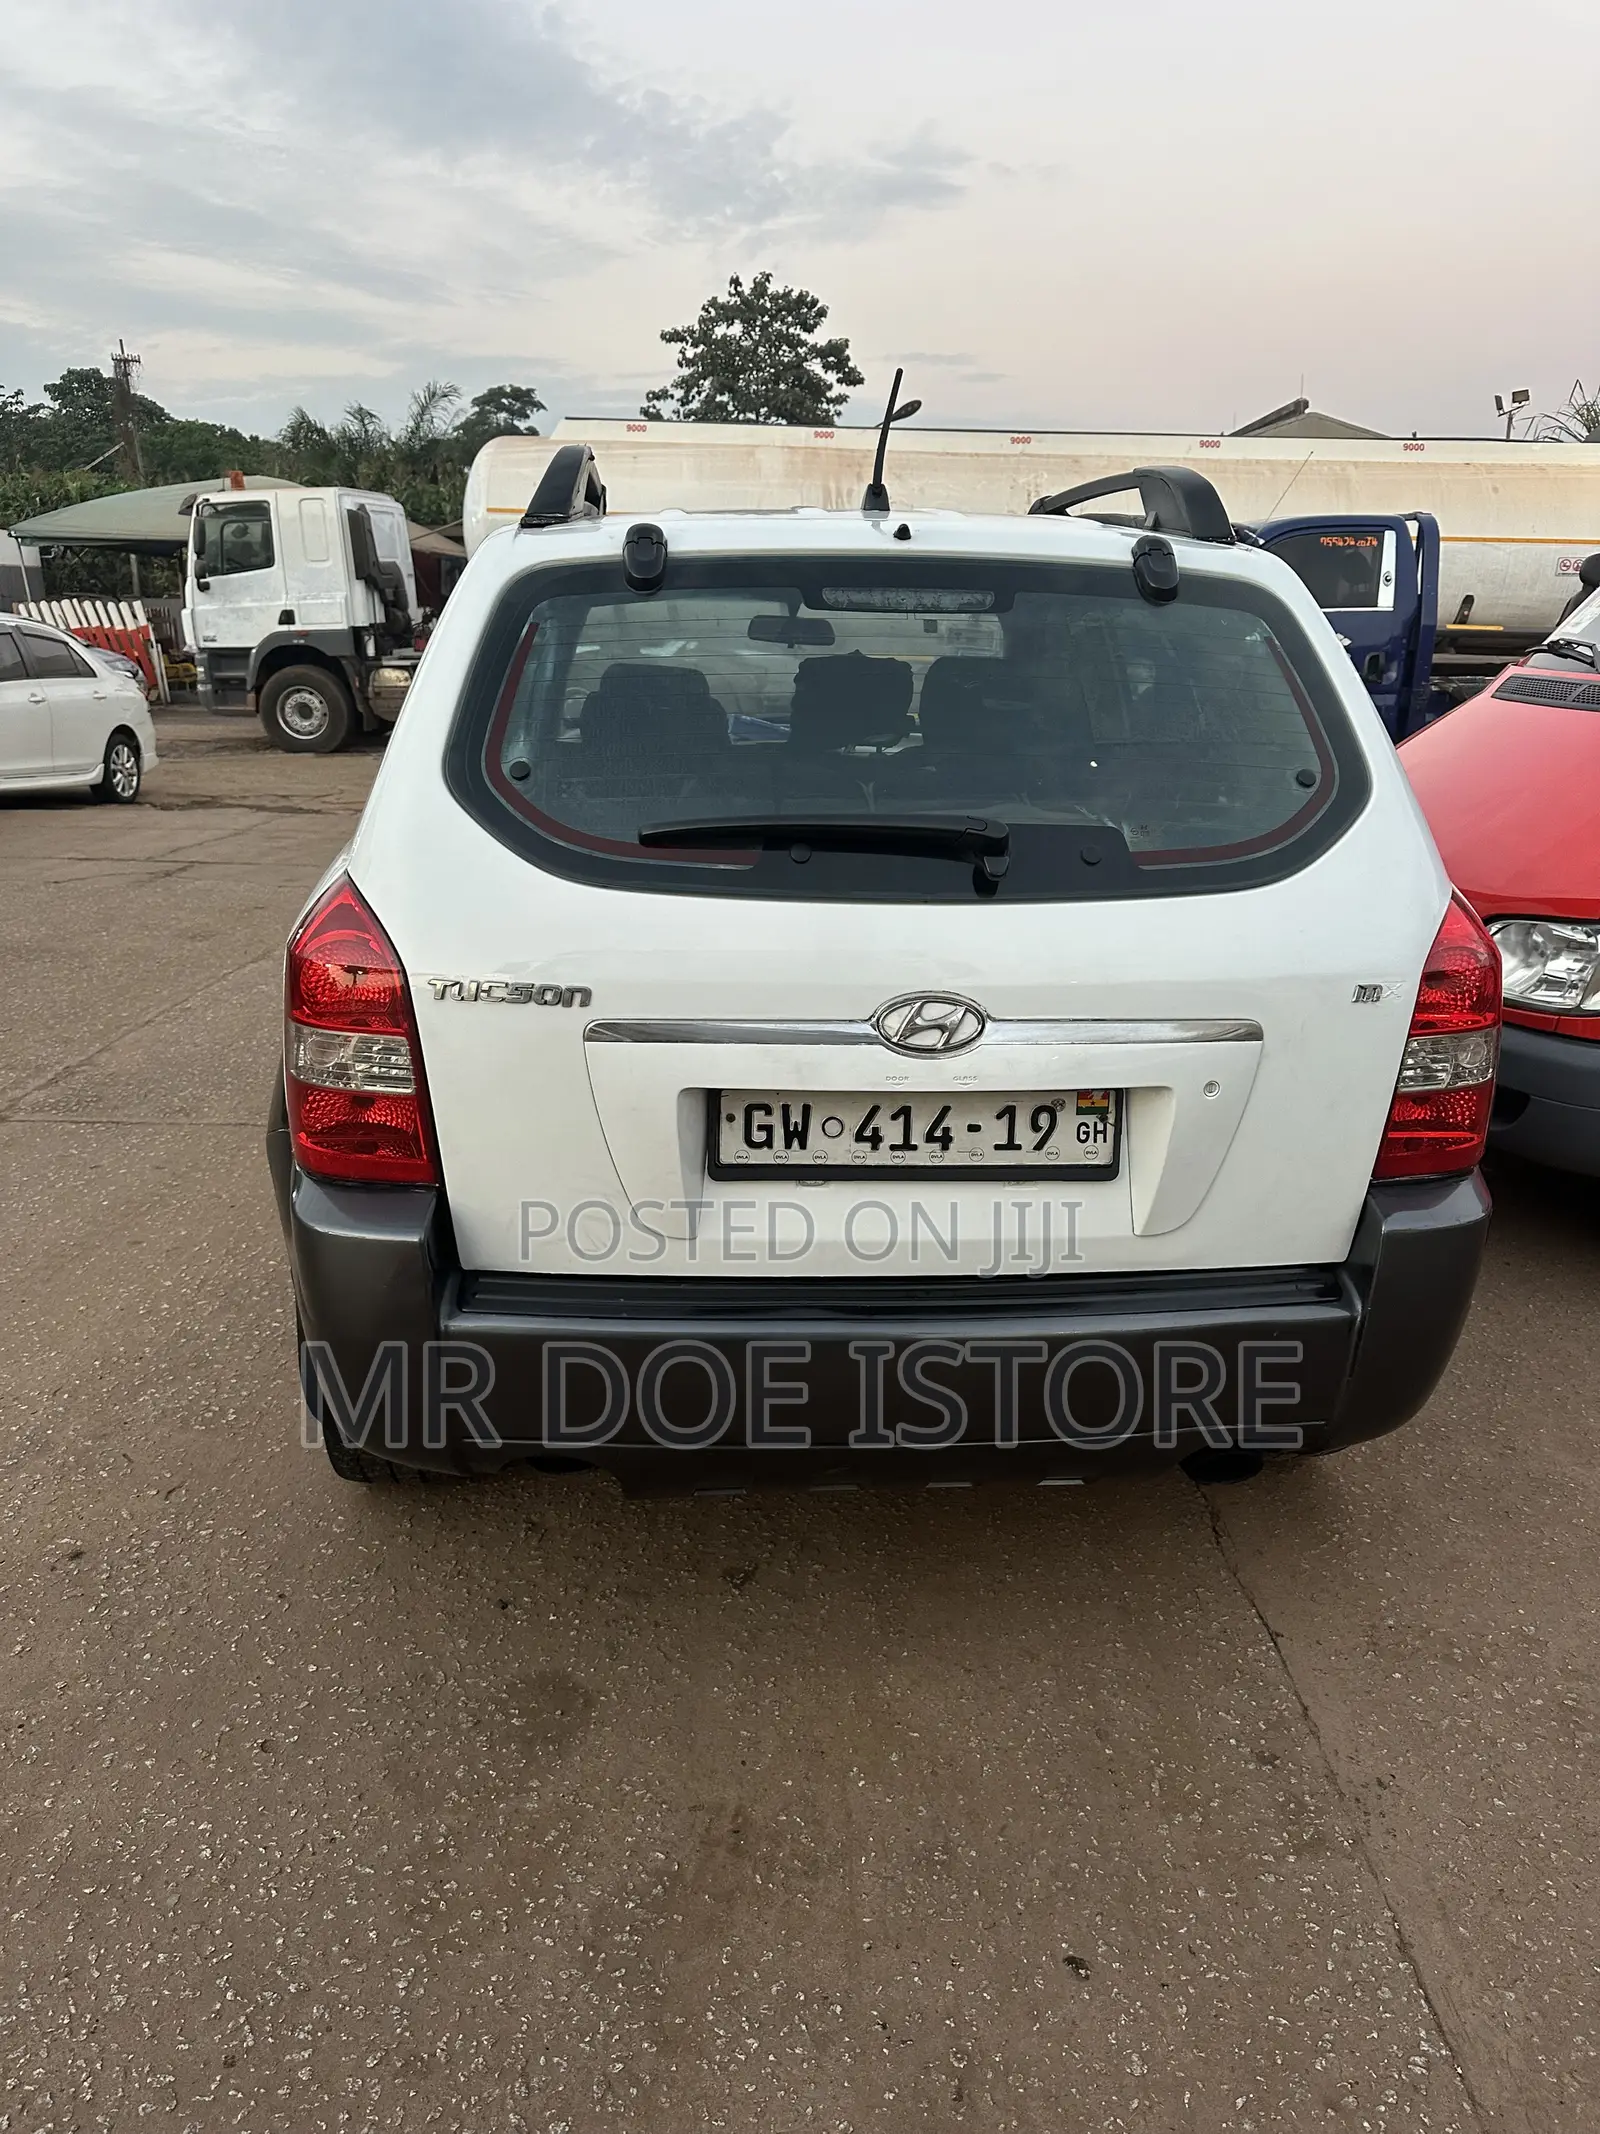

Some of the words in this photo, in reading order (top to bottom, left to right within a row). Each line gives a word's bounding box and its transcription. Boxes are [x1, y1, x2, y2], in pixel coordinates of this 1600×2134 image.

[626, 424, 647, 433] 9000
[814, 431, 835, 439] 9000
[1010, 436, 1031, 445] 9000
[1199, 440, 1221, 448] 9000
[1403, 443, 1425, 451] 9000
[744, 1103, 811, 1150] GW
[1076, 1121, 1107, 1144] GH
